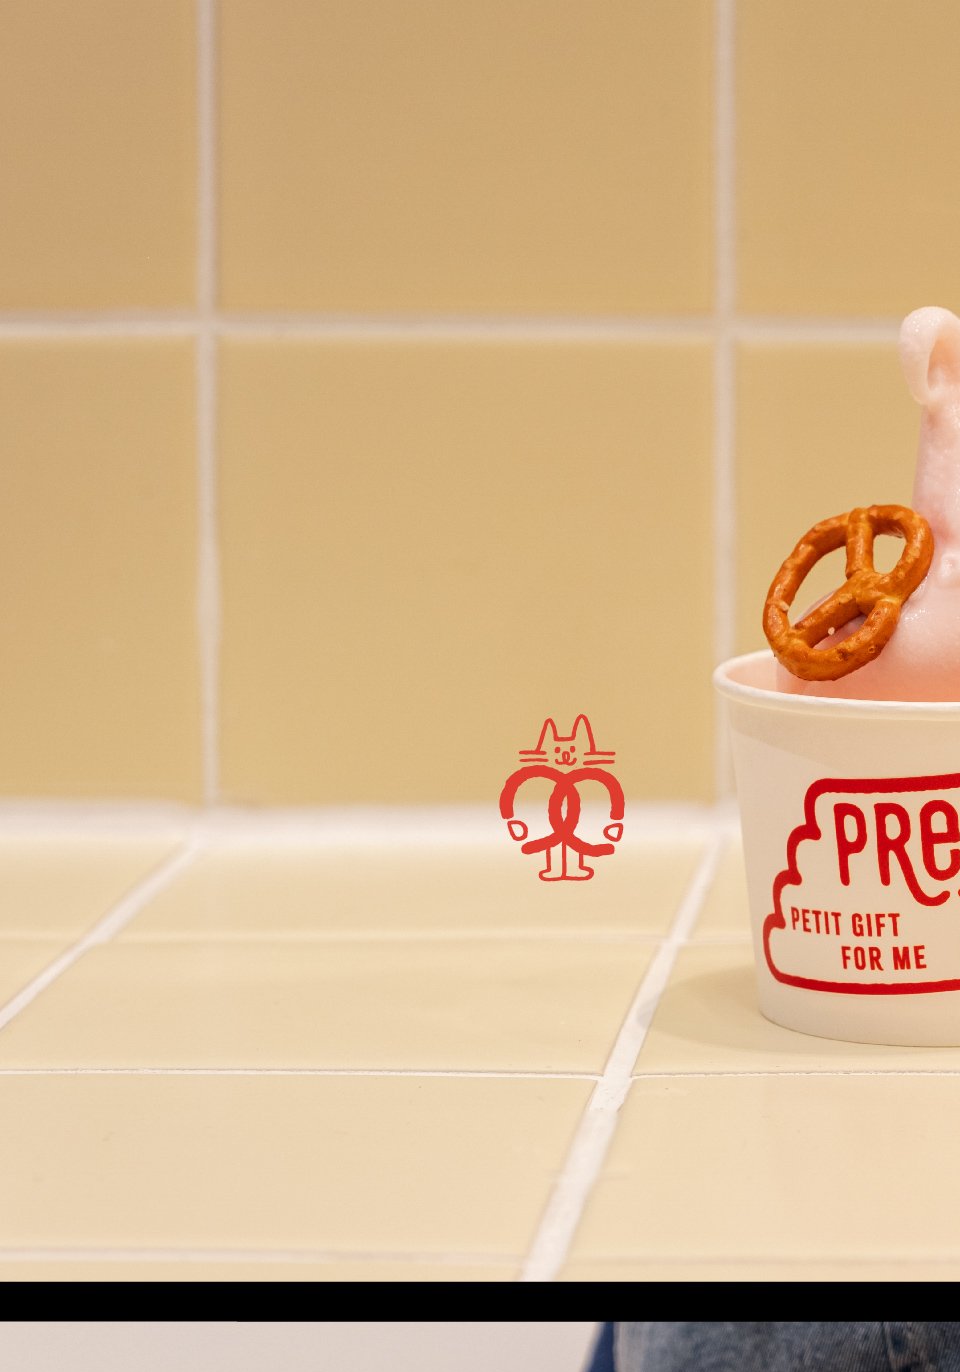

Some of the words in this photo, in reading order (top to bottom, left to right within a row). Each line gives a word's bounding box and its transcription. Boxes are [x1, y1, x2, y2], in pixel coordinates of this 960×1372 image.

[790, 906, 842, 936] PETIT
[851, 912, 900, 937] GIFT
[841, 945, 884, 971] FOR
[892, 945, 927, 970] ME
